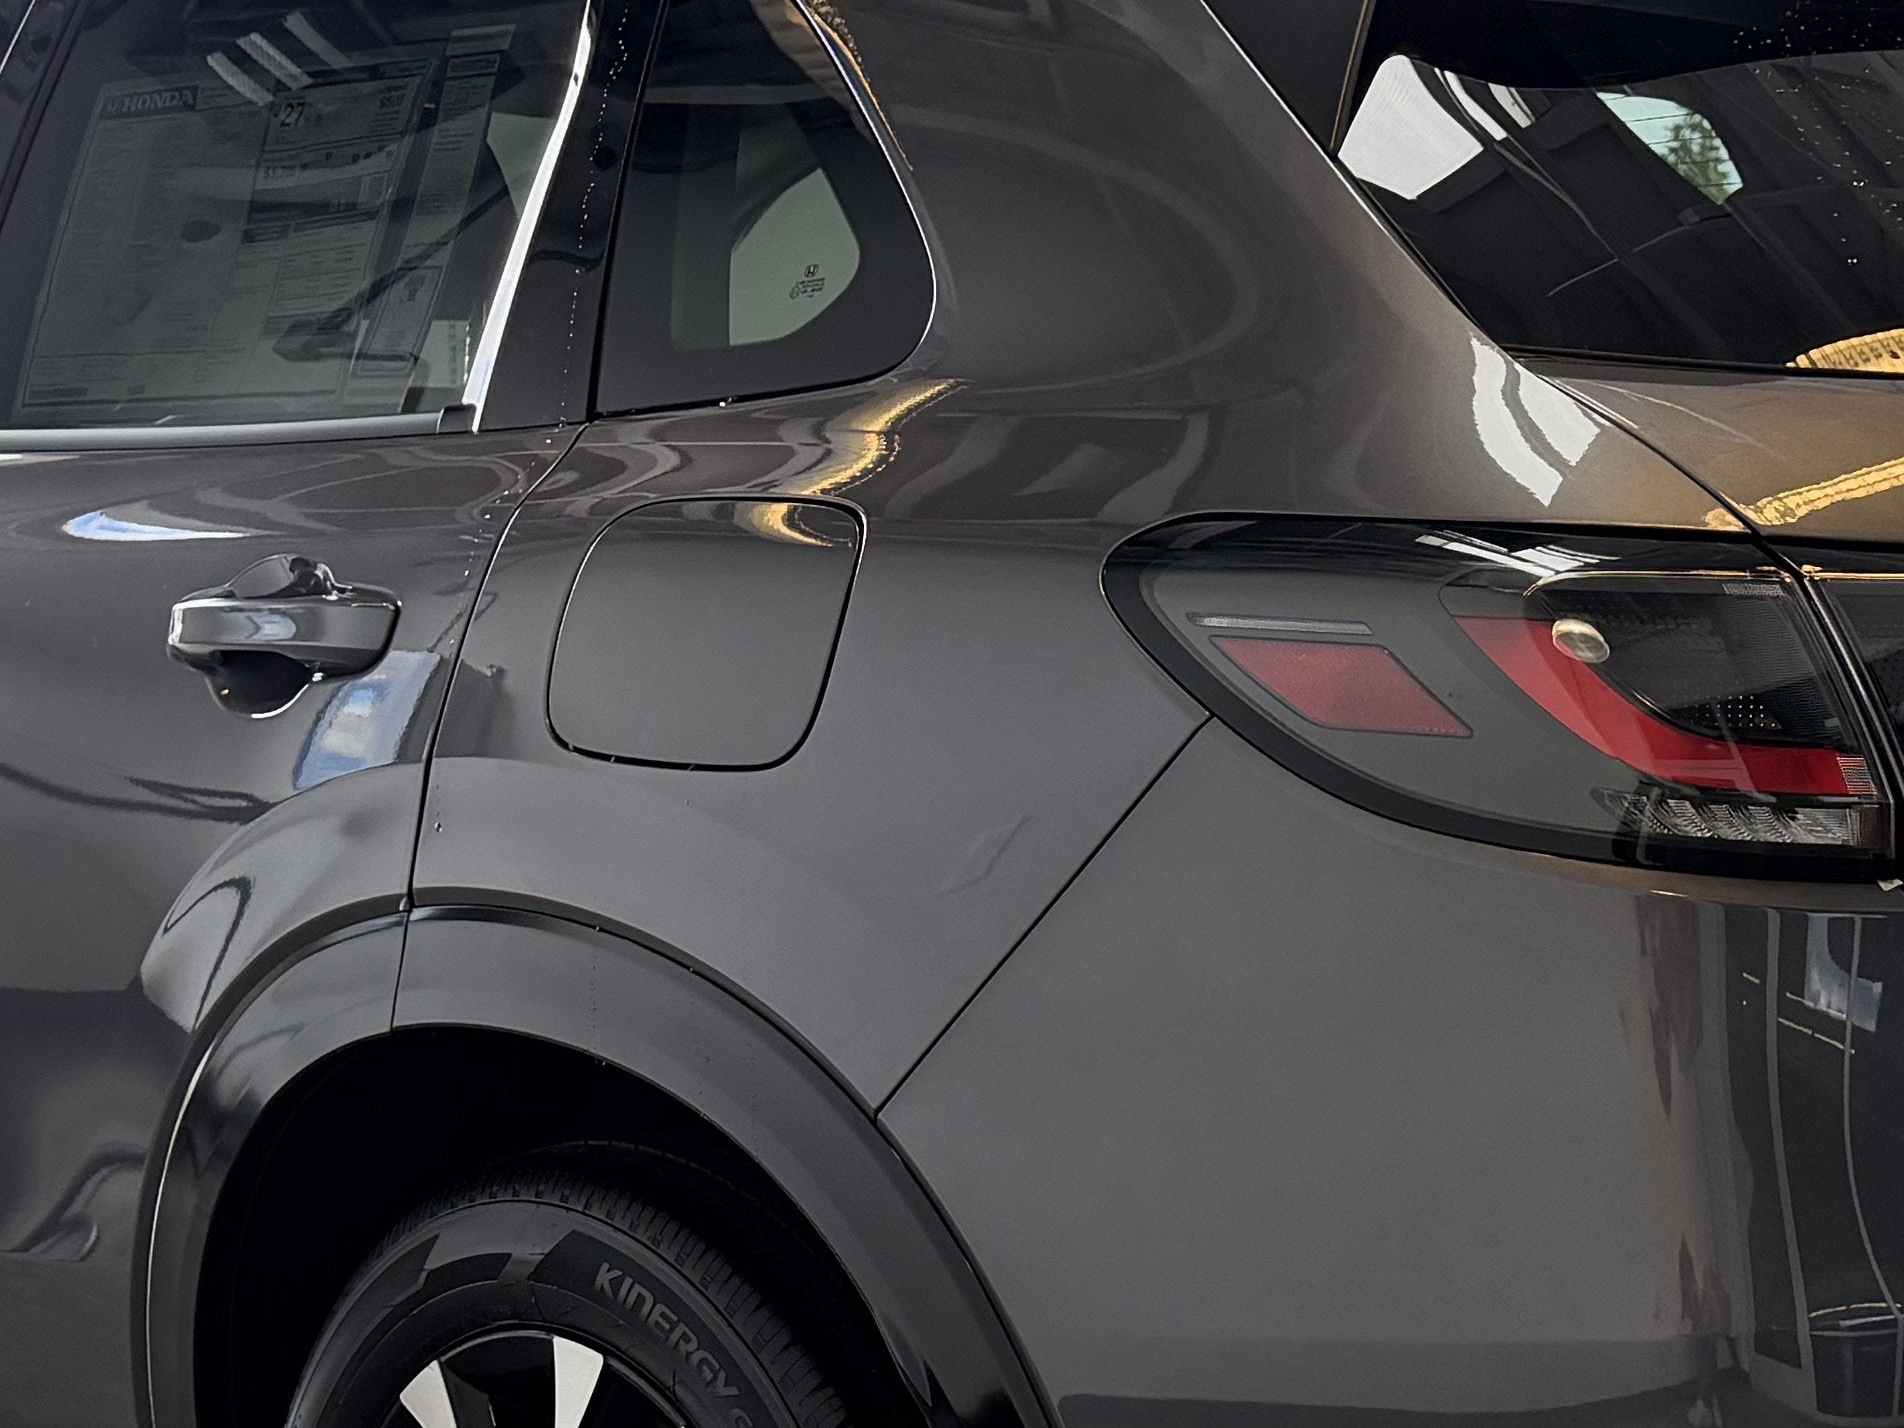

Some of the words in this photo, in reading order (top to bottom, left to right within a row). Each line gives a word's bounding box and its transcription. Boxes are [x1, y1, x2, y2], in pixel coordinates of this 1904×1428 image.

[121, 90, 195, 113] HONDA
[280, 101, 307, 128] 27
[593, 1260, 741, 1398] KINERGY
